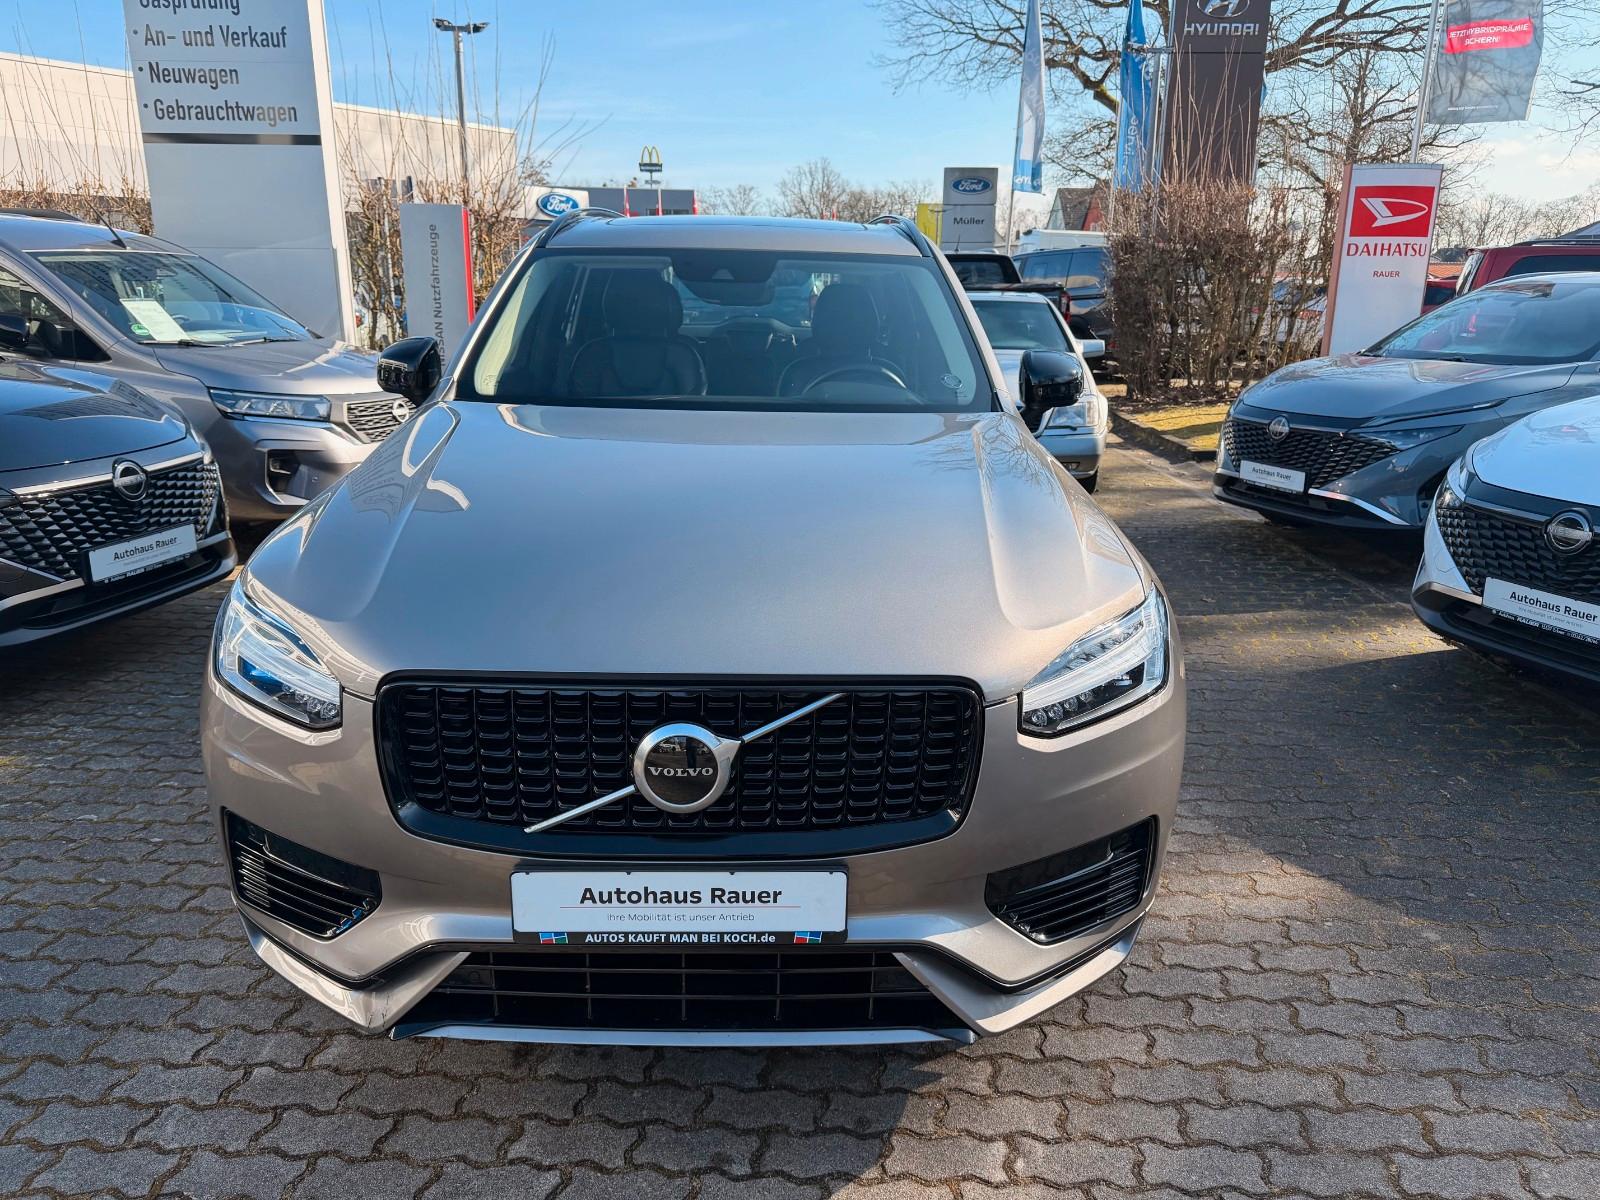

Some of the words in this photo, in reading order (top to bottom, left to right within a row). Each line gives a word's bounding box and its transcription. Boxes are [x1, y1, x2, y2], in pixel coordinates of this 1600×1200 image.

[144, 23, 176, 46] An-
[182, 25, 215, 47] und
[219, 25, 288, 48] Verkauf
[1184, 23, 1259, 36] HYUNDAI
[148, 61, 240, 90] Neuwagen
[153, 98, 298, 127] Gebrauchtwagen
[957, 179, 985, 192] Ford
[546, 194, 574, 213] Ford
[952, 216, 985, 226] Müller
[1346, 242, 1428, 257] DAIHATSU
[428, 224, 443, 319] Nutzfahrzeuge
[1372, 270, 1400, 278] RAUER
[113, 543, 154, 561] Autohaus
[155, 536, 178, 549] Rauer
[1509, 591, 1561, 613] Autohaus
[1563, 605, 1598, 622] Rauer
[648, 766, 714, 777] VOLVO
[579, 886, 702, 905] Autohaus
[710, 887, 782, 905] Rauer
[628, 912, 672, 921] Mobilität
[674, 913, 687, 921] ist
[718, 912, 755, 921] Antrieb
[584, 933, 626, 943] AUTOS
[628, 933, 667, 943] KAUFT
[669, 933, 698, 943] MAN
[701, 933, 720, 943] BEI
[723, 932, 776, 943] KOCH.de
